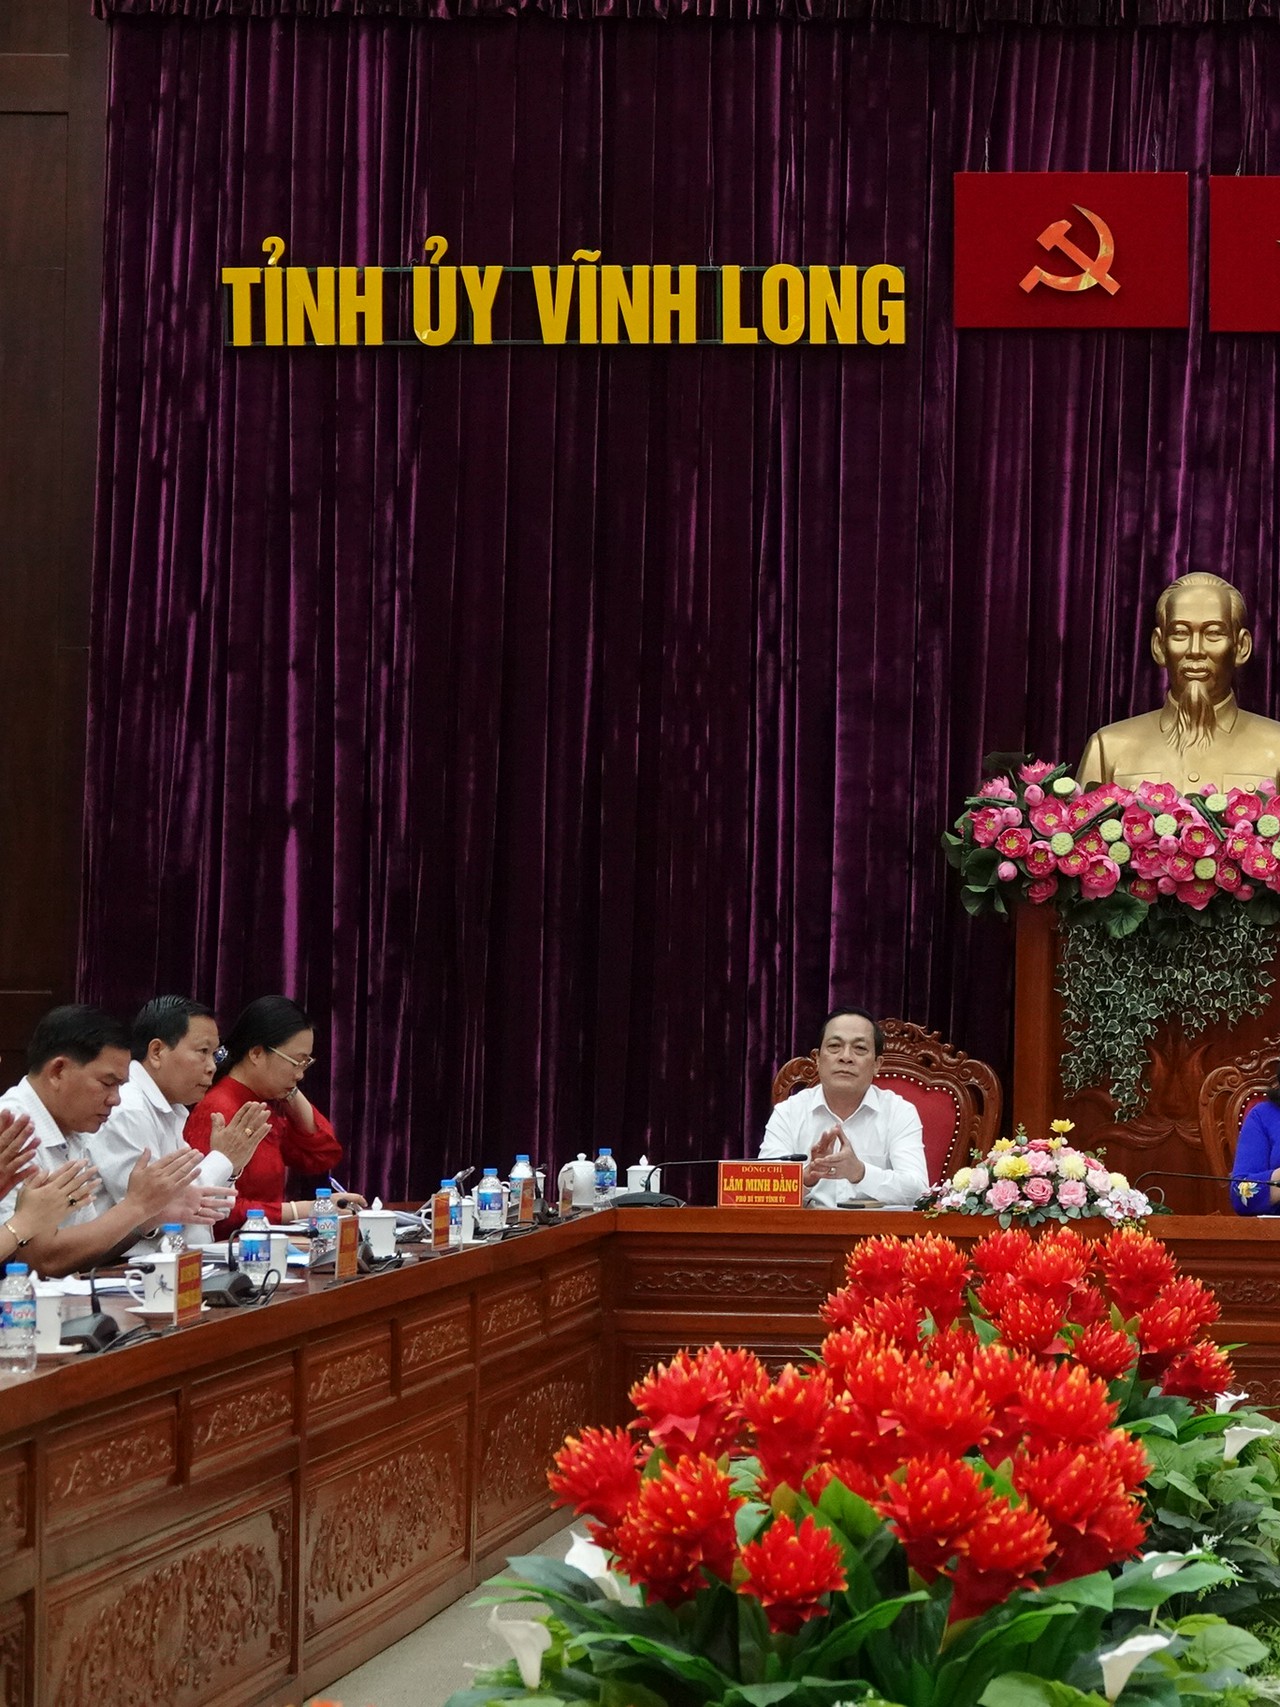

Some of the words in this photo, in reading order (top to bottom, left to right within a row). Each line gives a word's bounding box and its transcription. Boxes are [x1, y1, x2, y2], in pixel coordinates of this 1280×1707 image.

[222, 236, 384, 346] TỈNH
[413, 236, 503, 346] ỦY
[532, 248, 697, 344] VĨNH
[722, 263, 905, 345] LONG
[742, 1165, 766, 1173] ĐỒNG
[767, 1165, 783, 1173] CHÍ
[745, 1178, 770, 1192] MINH
